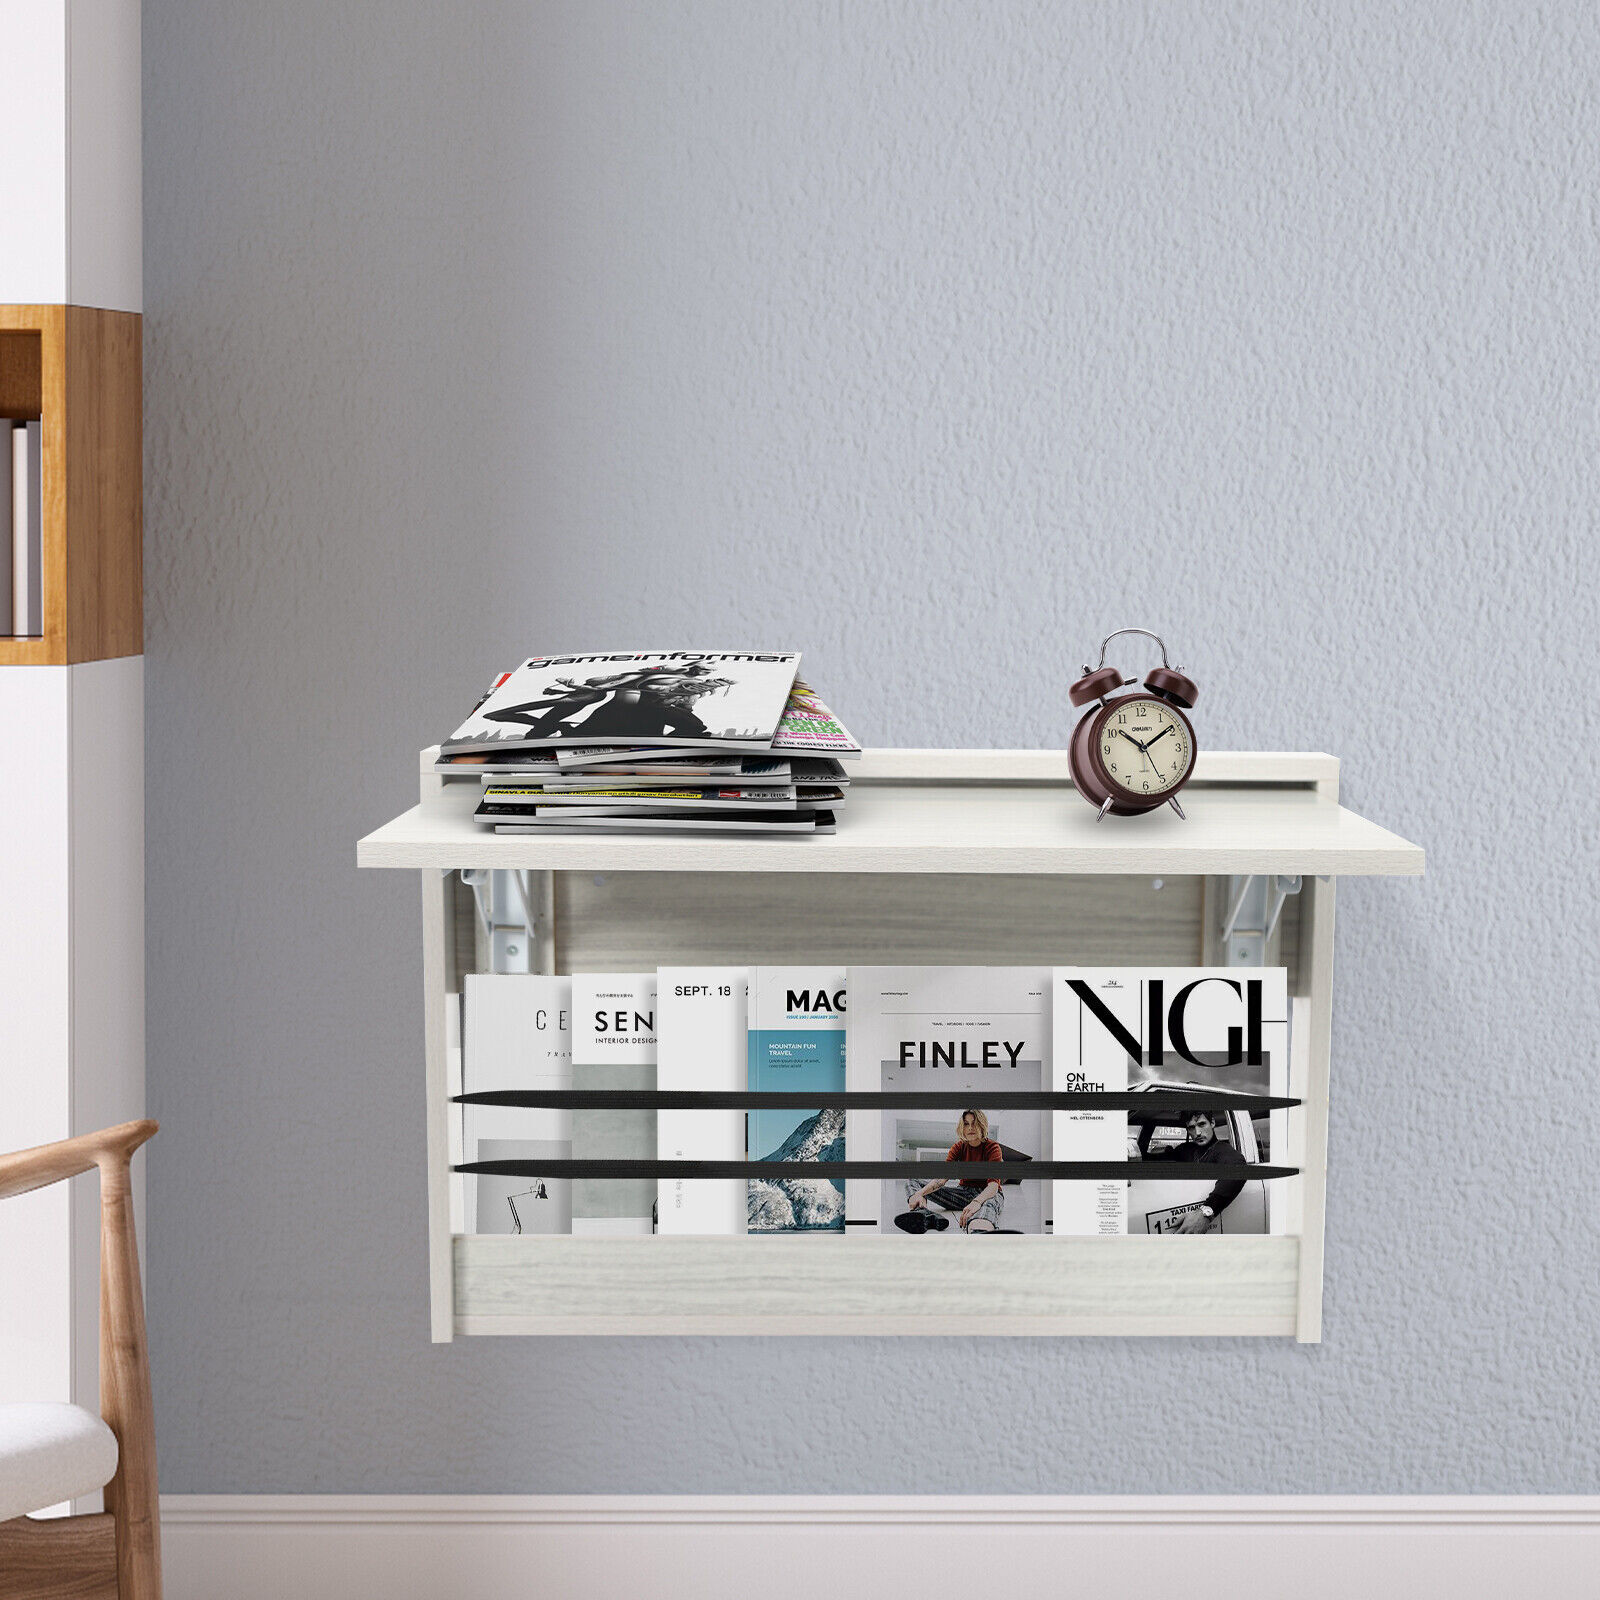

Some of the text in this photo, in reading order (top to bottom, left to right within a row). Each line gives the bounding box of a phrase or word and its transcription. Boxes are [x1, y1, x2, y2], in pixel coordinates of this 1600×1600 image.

[1136, 707, 1146, 716] 12
[1118, 714, 1126, 724] 11
[1159, 714, 1163, 722] 1
[1108, 728, 1118, 738] 10
[1104, 745, 1110, 754] 9
[1175, 743, 1181, 752] 3
[1111, 763, 1117, 772] 8
[1171, 762, 1177, 770] 4
[1126, 776, 1131, 785] 7
[1160, 774, 1166, 783] 5
[1143, 781, 1149, 790] 6
[675, 986, 731, 996] SEPT. 18
[787, 990, 846, 1012] MAG
[595, 1011, 653, 1032] SEN
[900, 1042, 1025, 1068] FINLEY
[1067, 1073, 1085, 1082] ON
[1067, 1083, 1104, 1092] EARTH
[1170, 1206, 1186, 1216] TAXI
